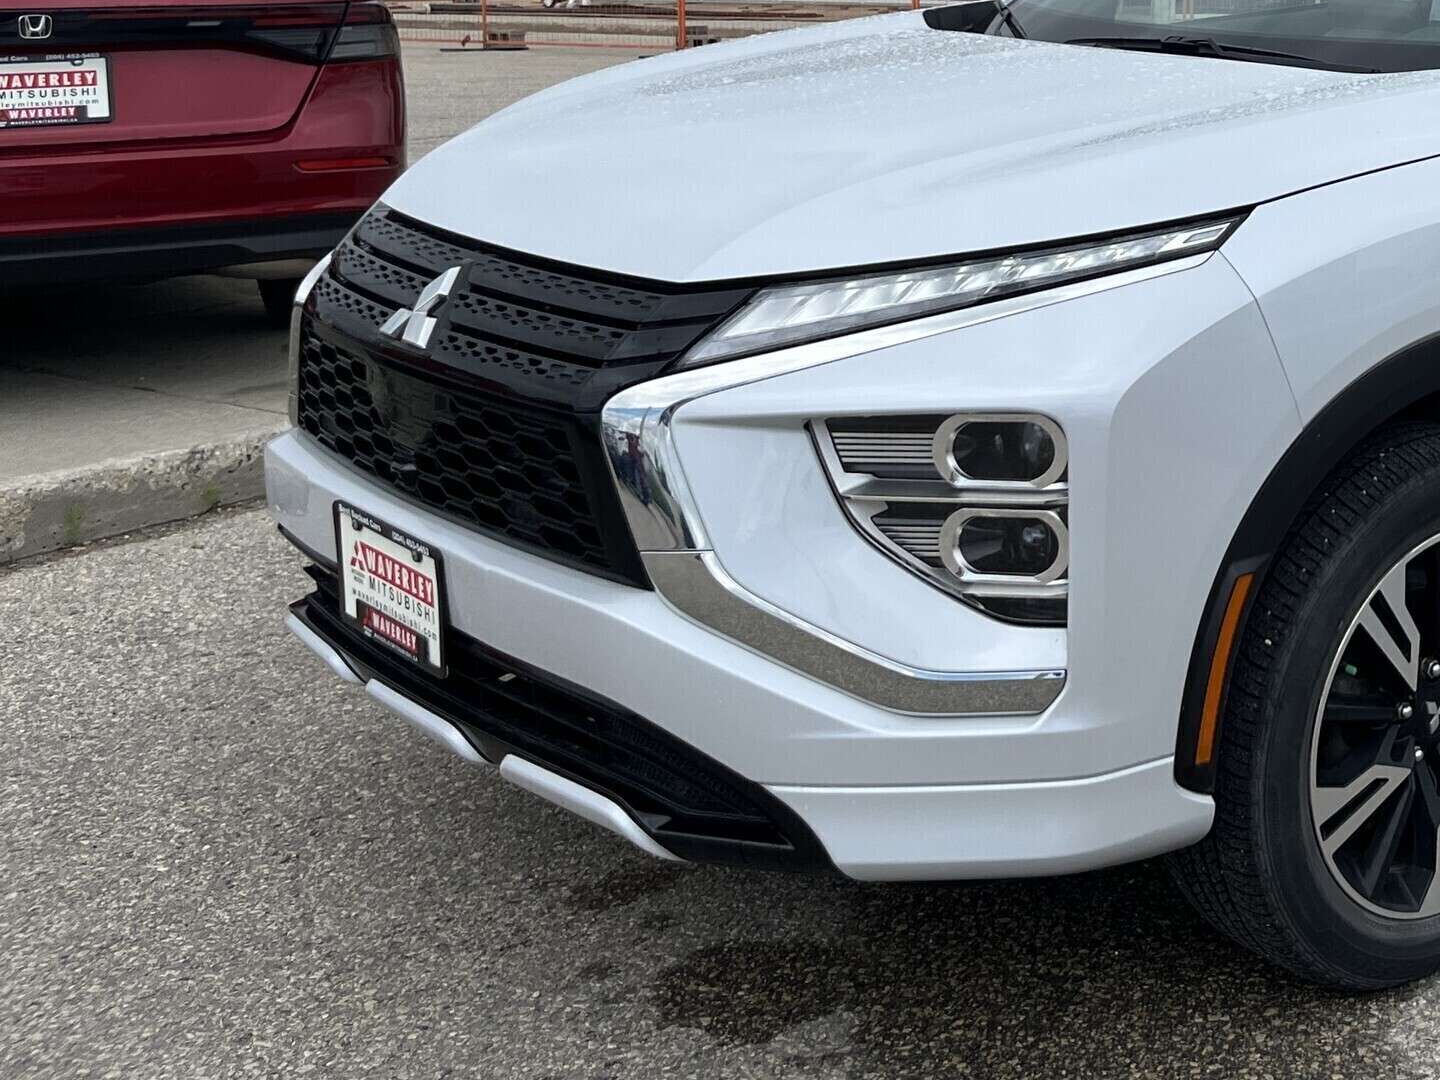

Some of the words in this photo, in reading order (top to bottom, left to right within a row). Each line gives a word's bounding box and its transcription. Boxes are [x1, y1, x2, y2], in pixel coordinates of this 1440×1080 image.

[0, 72, 95, 88] WAVERLEY
[0, 88, 97, 99] MITSUBISHI
[0, 99, 100, 109] leymitsubishi.com
[9, 107, 76, 119] WAVERLEY
[364, 548, 433, 604] WAVERLEY
[369, 575, 436, 625] MITSUBISHI
[372, 612, 417, 651] WAVERLEY
